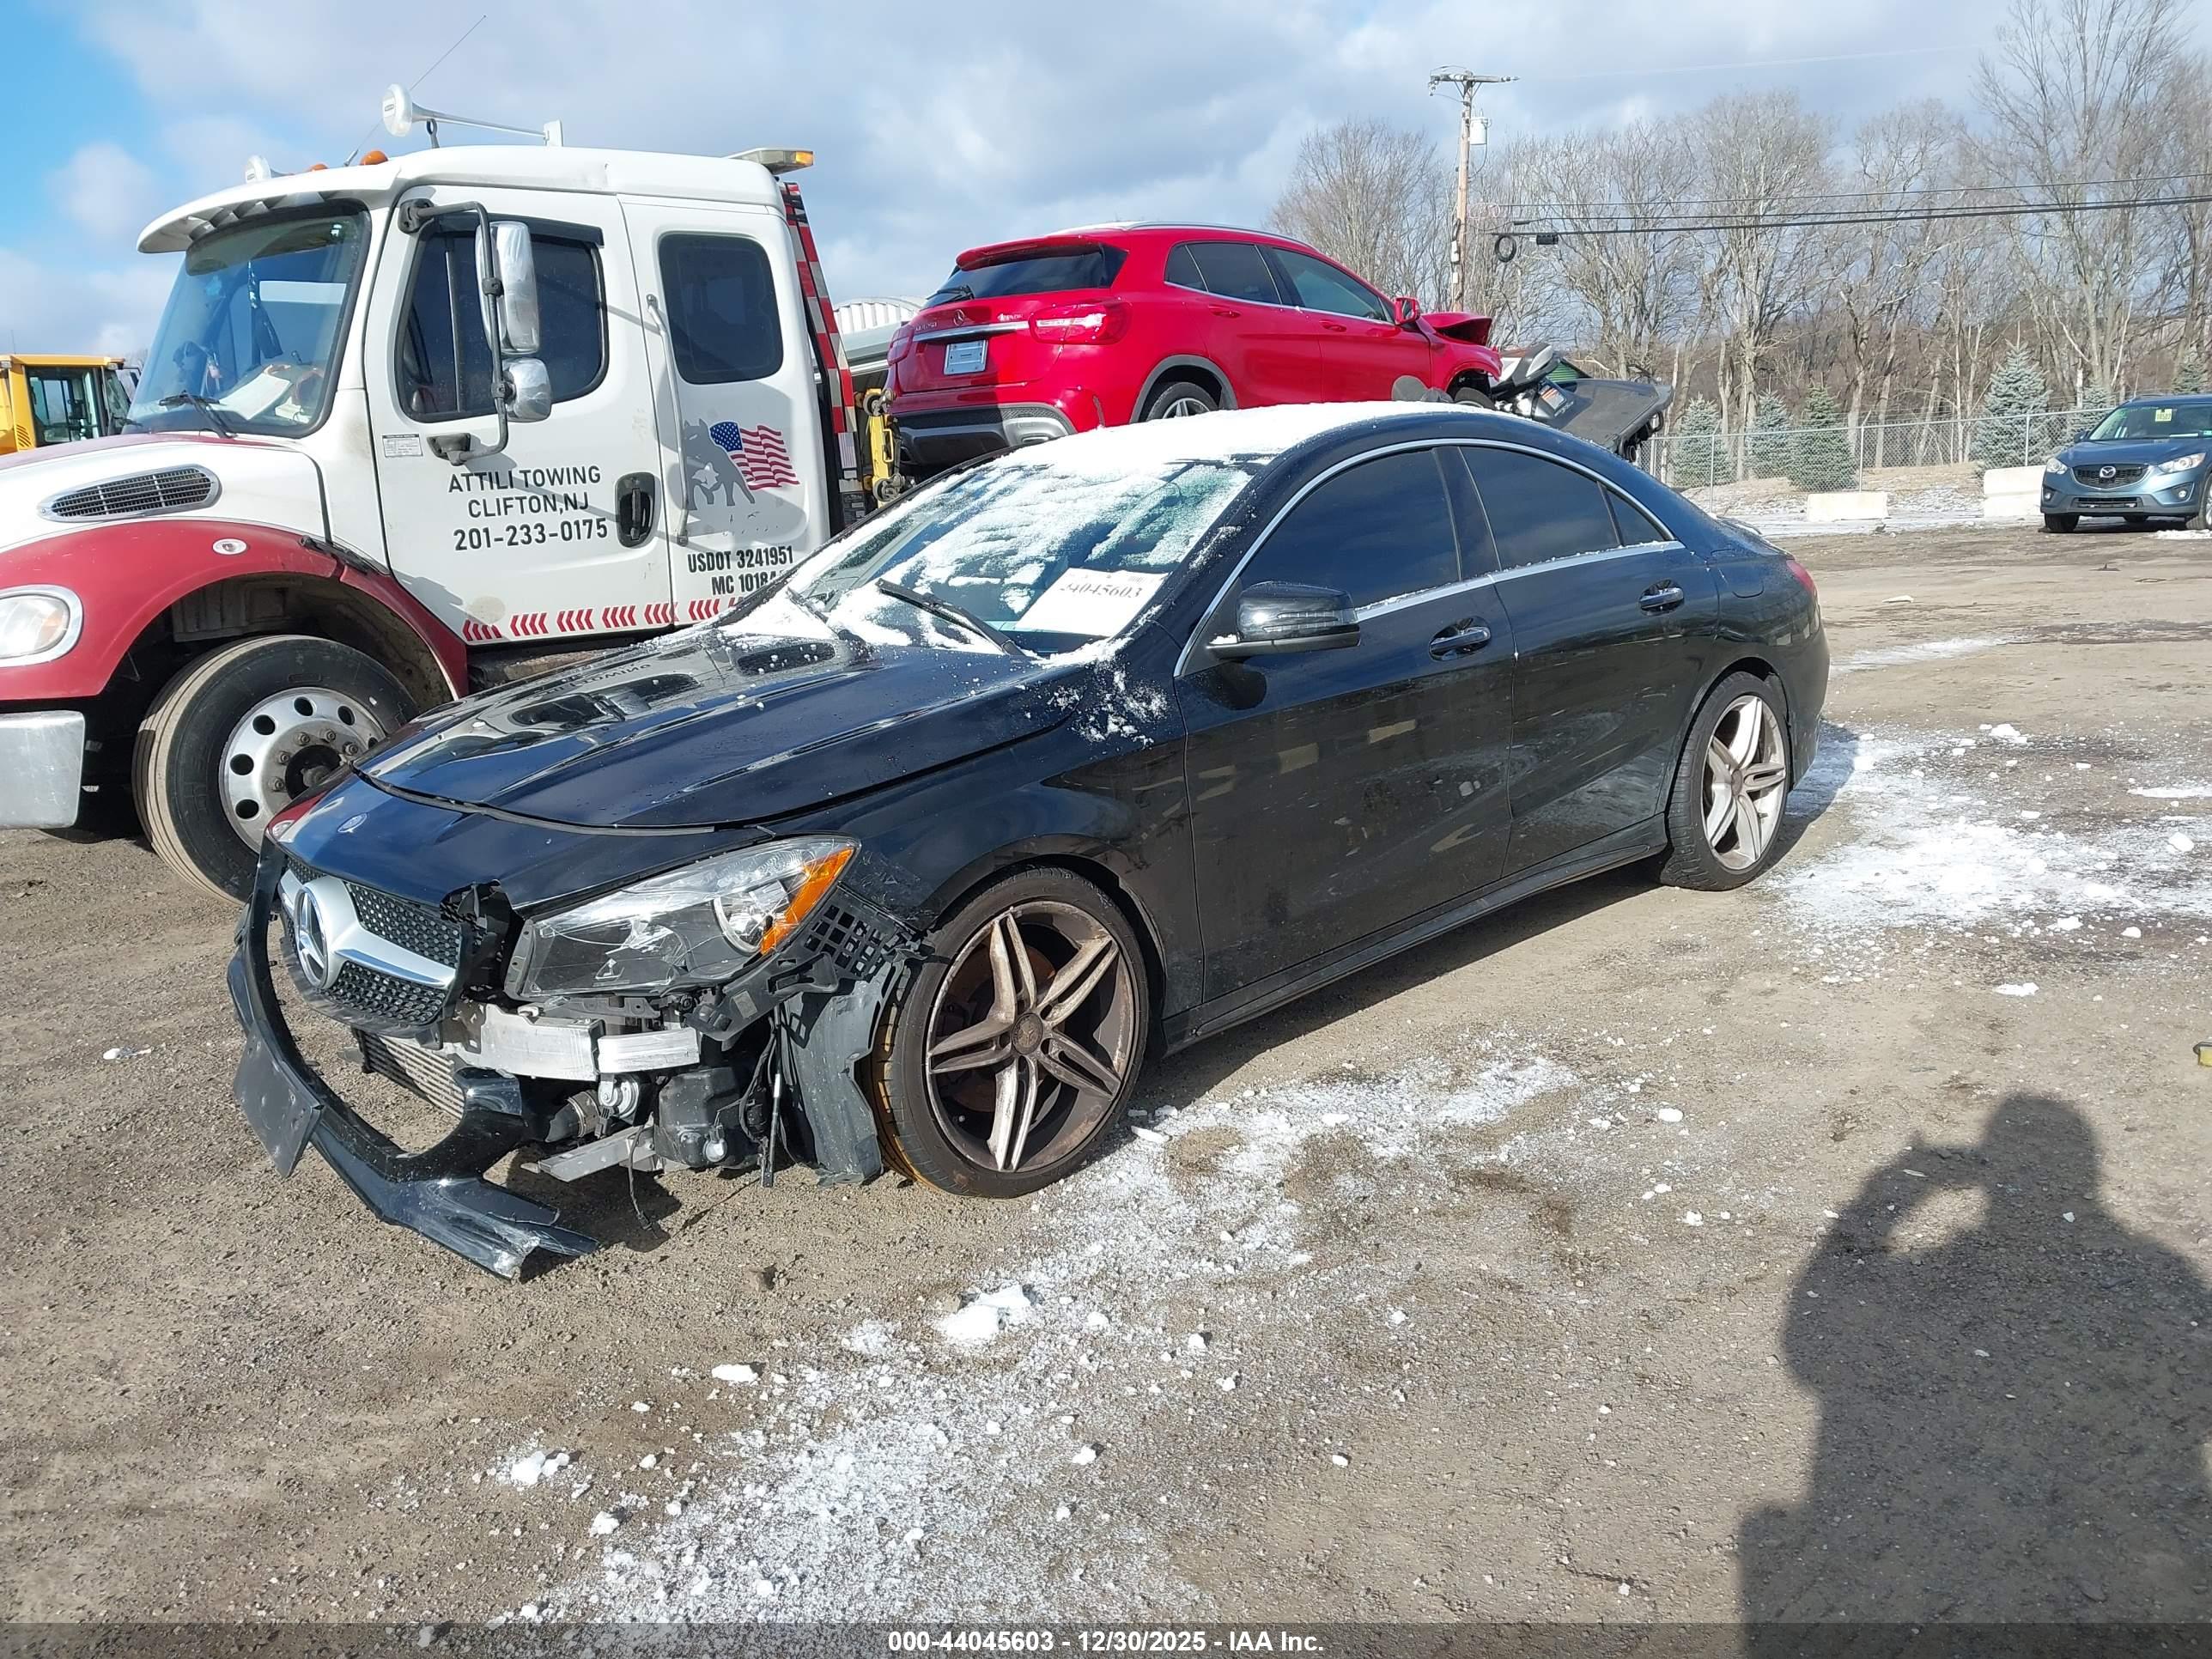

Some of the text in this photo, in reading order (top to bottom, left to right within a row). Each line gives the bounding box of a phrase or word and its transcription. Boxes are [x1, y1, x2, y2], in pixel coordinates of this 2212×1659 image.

[448, 465, 601, 492] ATTILI TOWING
[468, 492, 589, 518] CLIFTON,NJ
[453, 518, 608, 550] 201-233-0175
[687, 545, 793, 573] USDOT 3241951
[711, 570, 787, 595] MC 1018
[1060, 584, 1142, 598] 4045603
